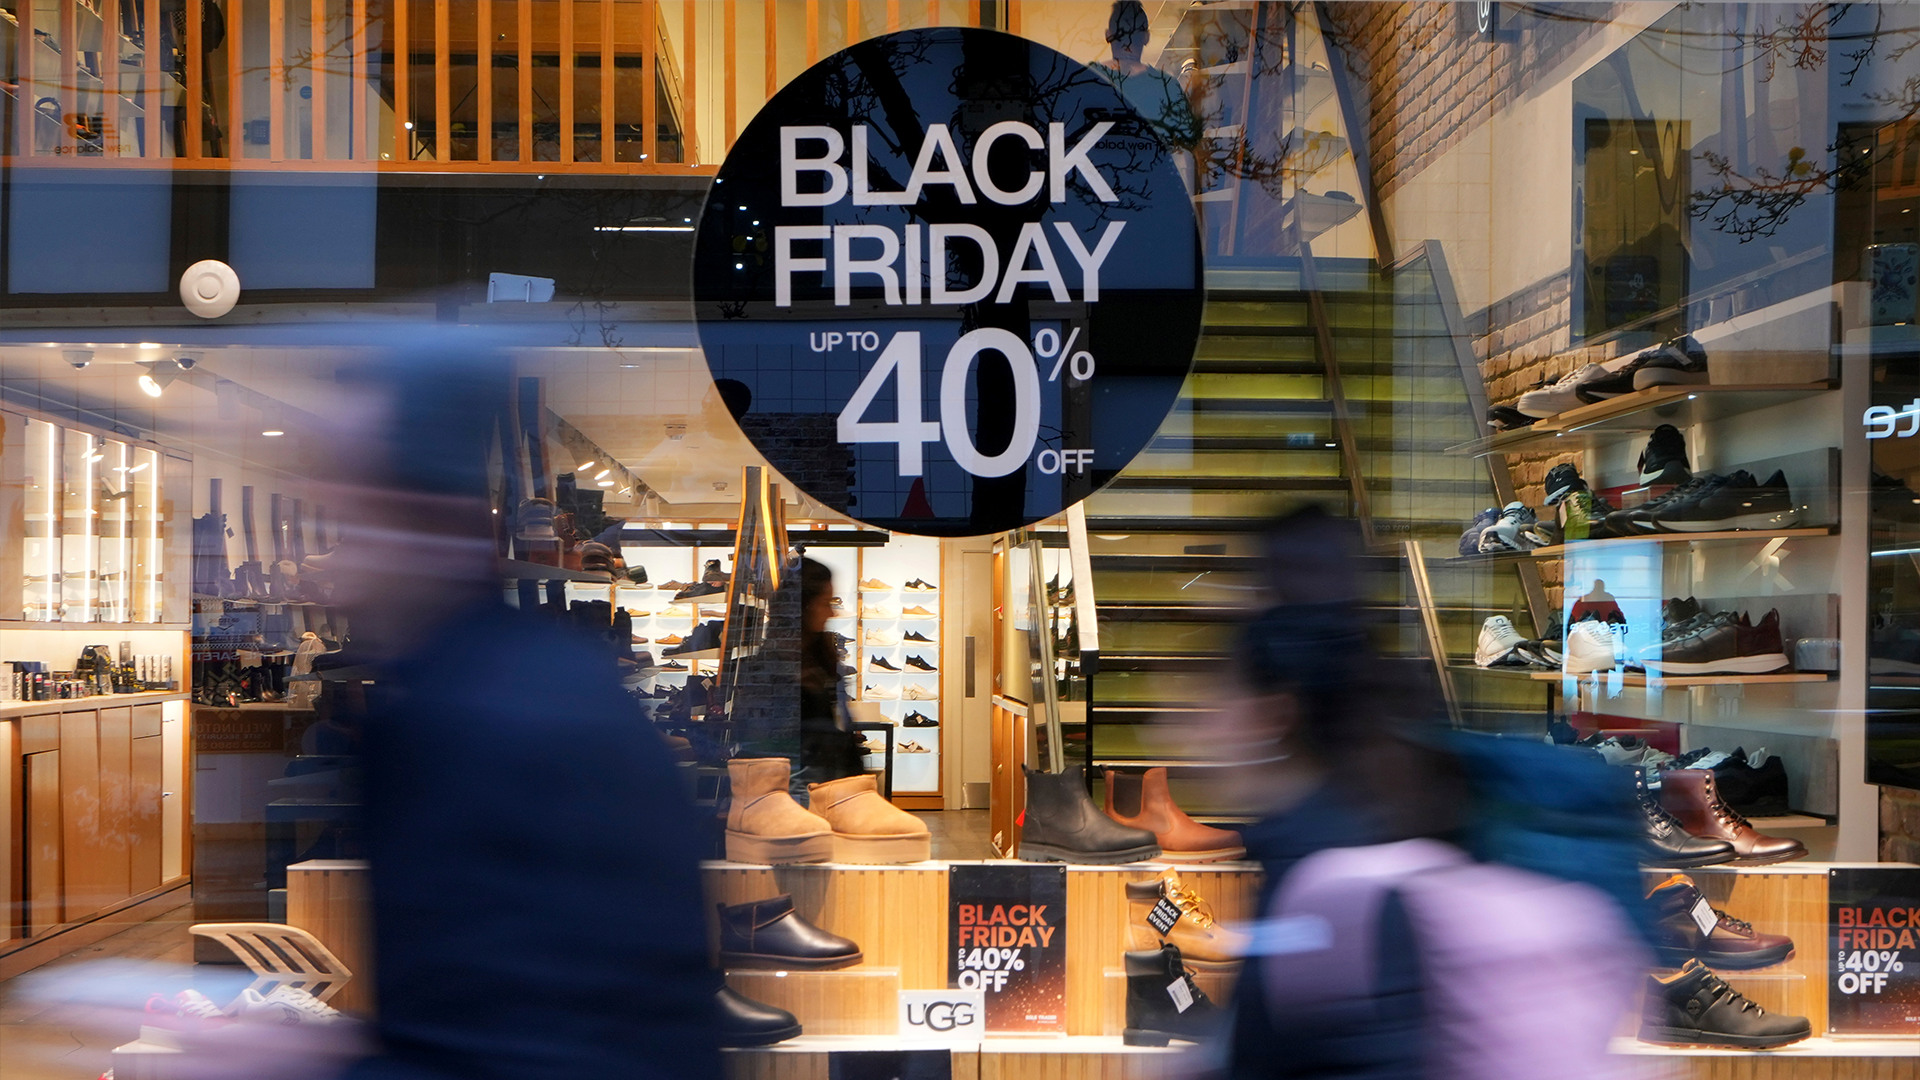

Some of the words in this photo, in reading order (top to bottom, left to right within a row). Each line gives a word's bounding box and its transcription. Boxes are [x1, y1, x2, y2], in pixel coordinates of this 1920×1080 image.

[781, 121, 1118, 206] BLACK
[775, 221, 1126, 306] FRIDAY
[810, 332, 843, 352] UP
[846, 331, 879, 352] TO
[837, 327, 1095, 478] 40%
[1037, 449, 1094, 474] OFF
[959, 905, 1047, 926] BLACK
[1153, 906, 1175, 926] FRIDAY
[1158, 899, 1178, 919] BLACK
[1148, 912, 1169, 932] EVENT
[959, 926, 1056, 948] FRIDAY
[1839, 928, 1920, 949] FRIDA
[965, 947, 1025, 971] 40%
[1838, 950, 1846, 960] TO
[1838, 960, 1846, 972] UP
[1845, 950, 1904, 972] 40%
[958, 970, 1009, 992] OFF
[1838, 972, 1889, 994] OFF
[906, 1001, 975, 1032] UGG
